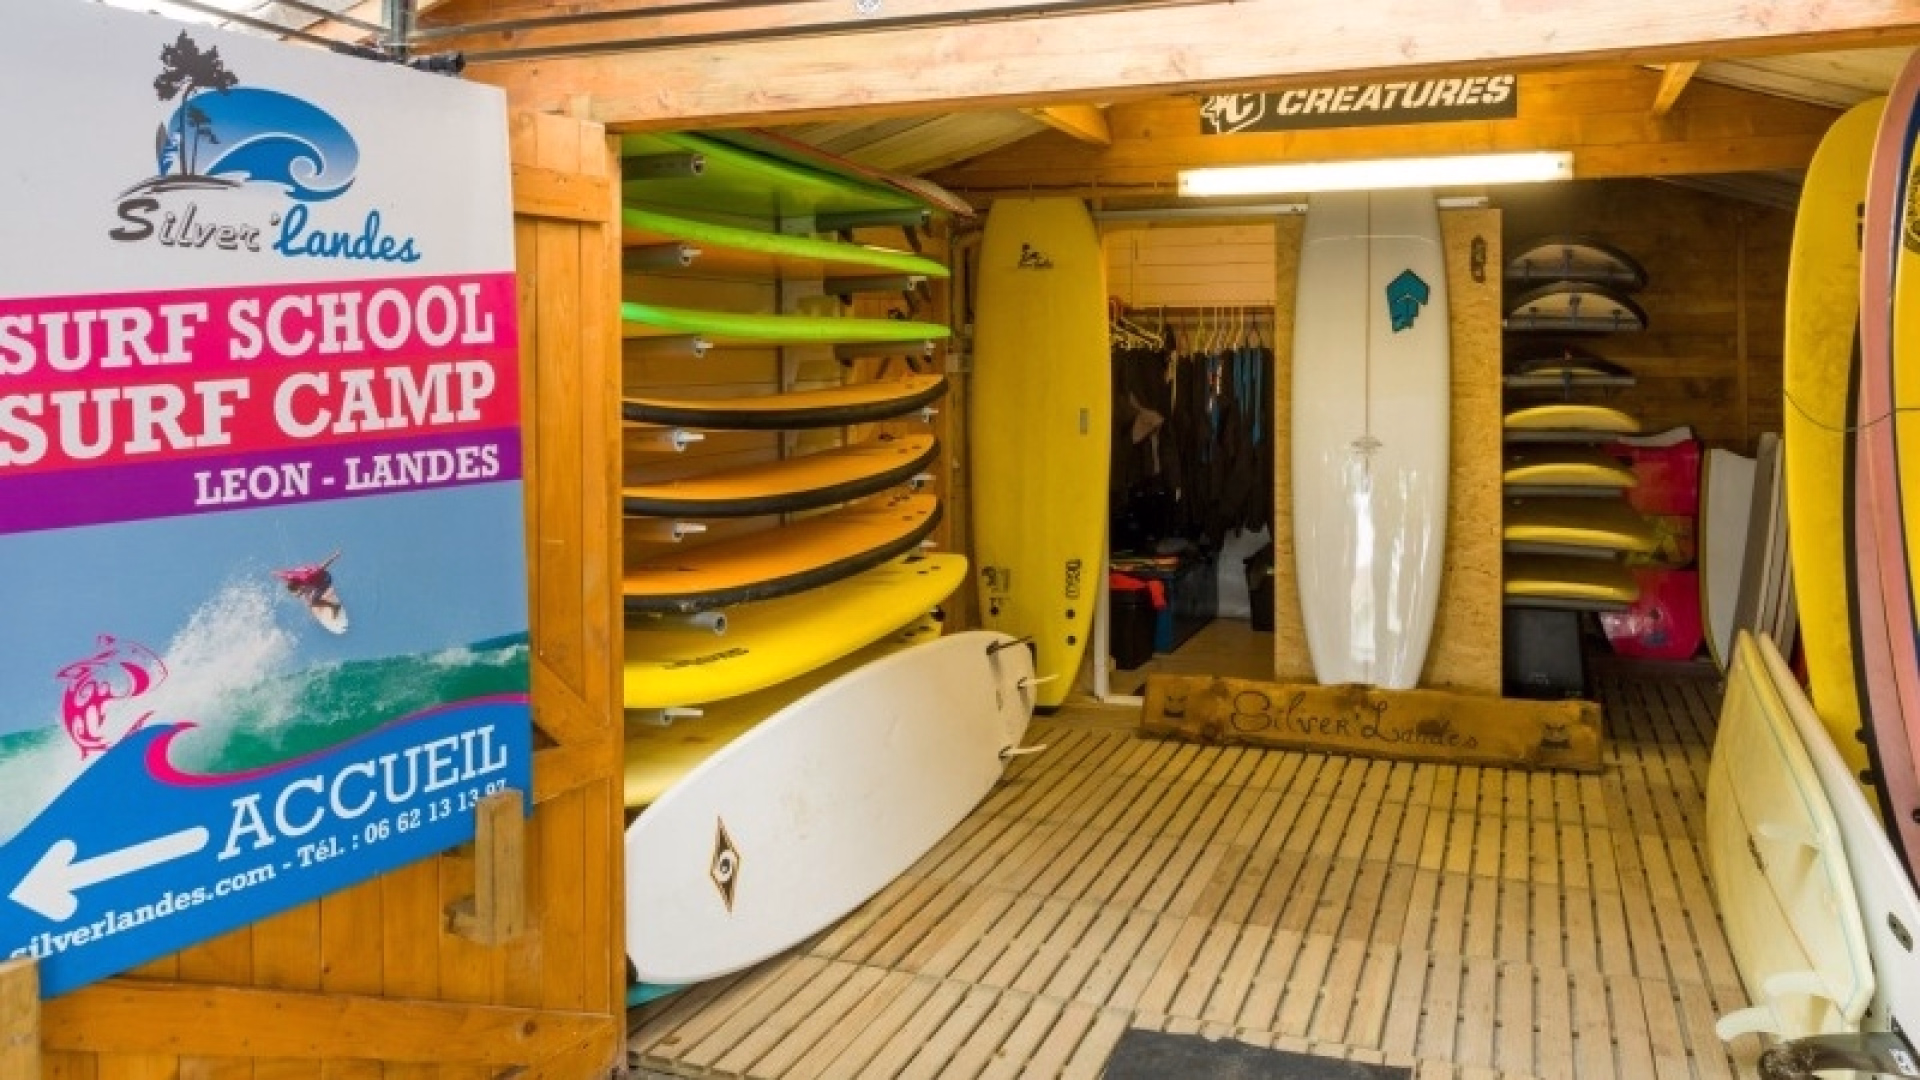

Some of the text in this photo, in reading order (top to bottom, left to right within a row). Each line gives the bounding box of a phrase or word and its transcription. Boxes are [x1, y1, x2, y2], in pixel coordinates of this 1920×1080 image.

[1278, 75, 1514, 115] CREATURES
[0, 282, 494, 375] SURF SCHOOL
[0, 359, 496, 466] SURF CAMP
[194, 461, 312, 507] LEON
[345, 444, 500, 491] LANDES
[217, 724, 507, 861] ACCUEIL
[297, 836, 345, 867] Tél.
[364, 818, 390, 845] 06
[397, 809, 421, 833] 62
[429, 798, 451, 820] 13
